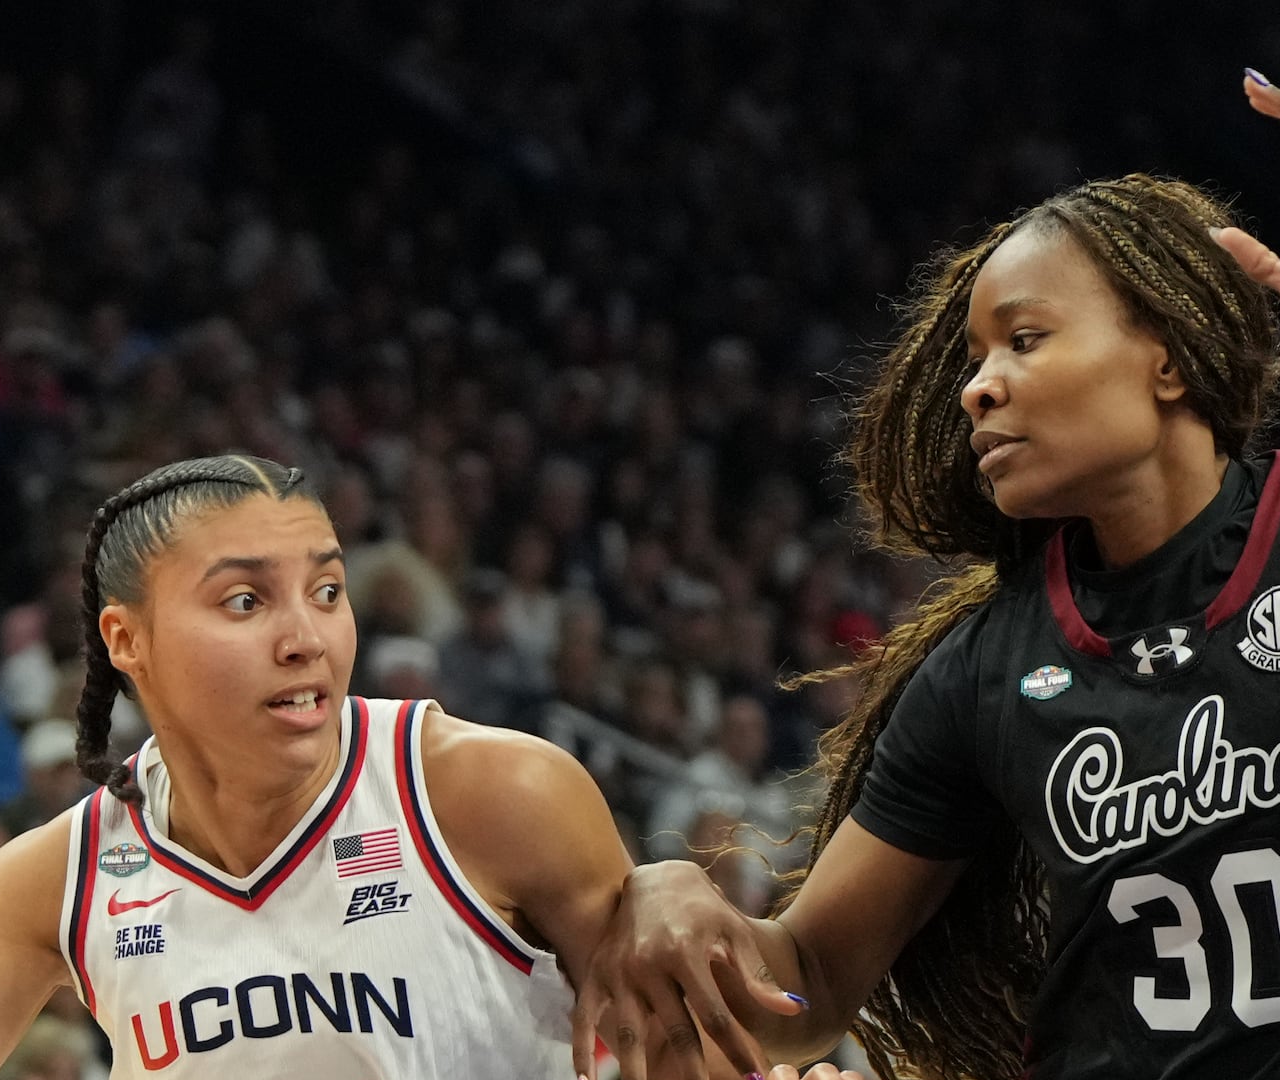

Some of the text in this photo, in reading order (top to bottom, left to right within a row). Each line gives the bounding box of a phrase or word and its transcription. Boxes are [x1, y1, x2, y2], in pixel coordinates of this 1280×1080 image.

[1023, 673, 1069, 690] FINAL FOUR
[100, 852, 146, 865] FINAL FOUR
[351, 880, 398, 901] BIG
[346, 893, 412, 916] EAST
[116, 924, 163, 944] BE THE
[131, 972, 414, 1071] UCONN
